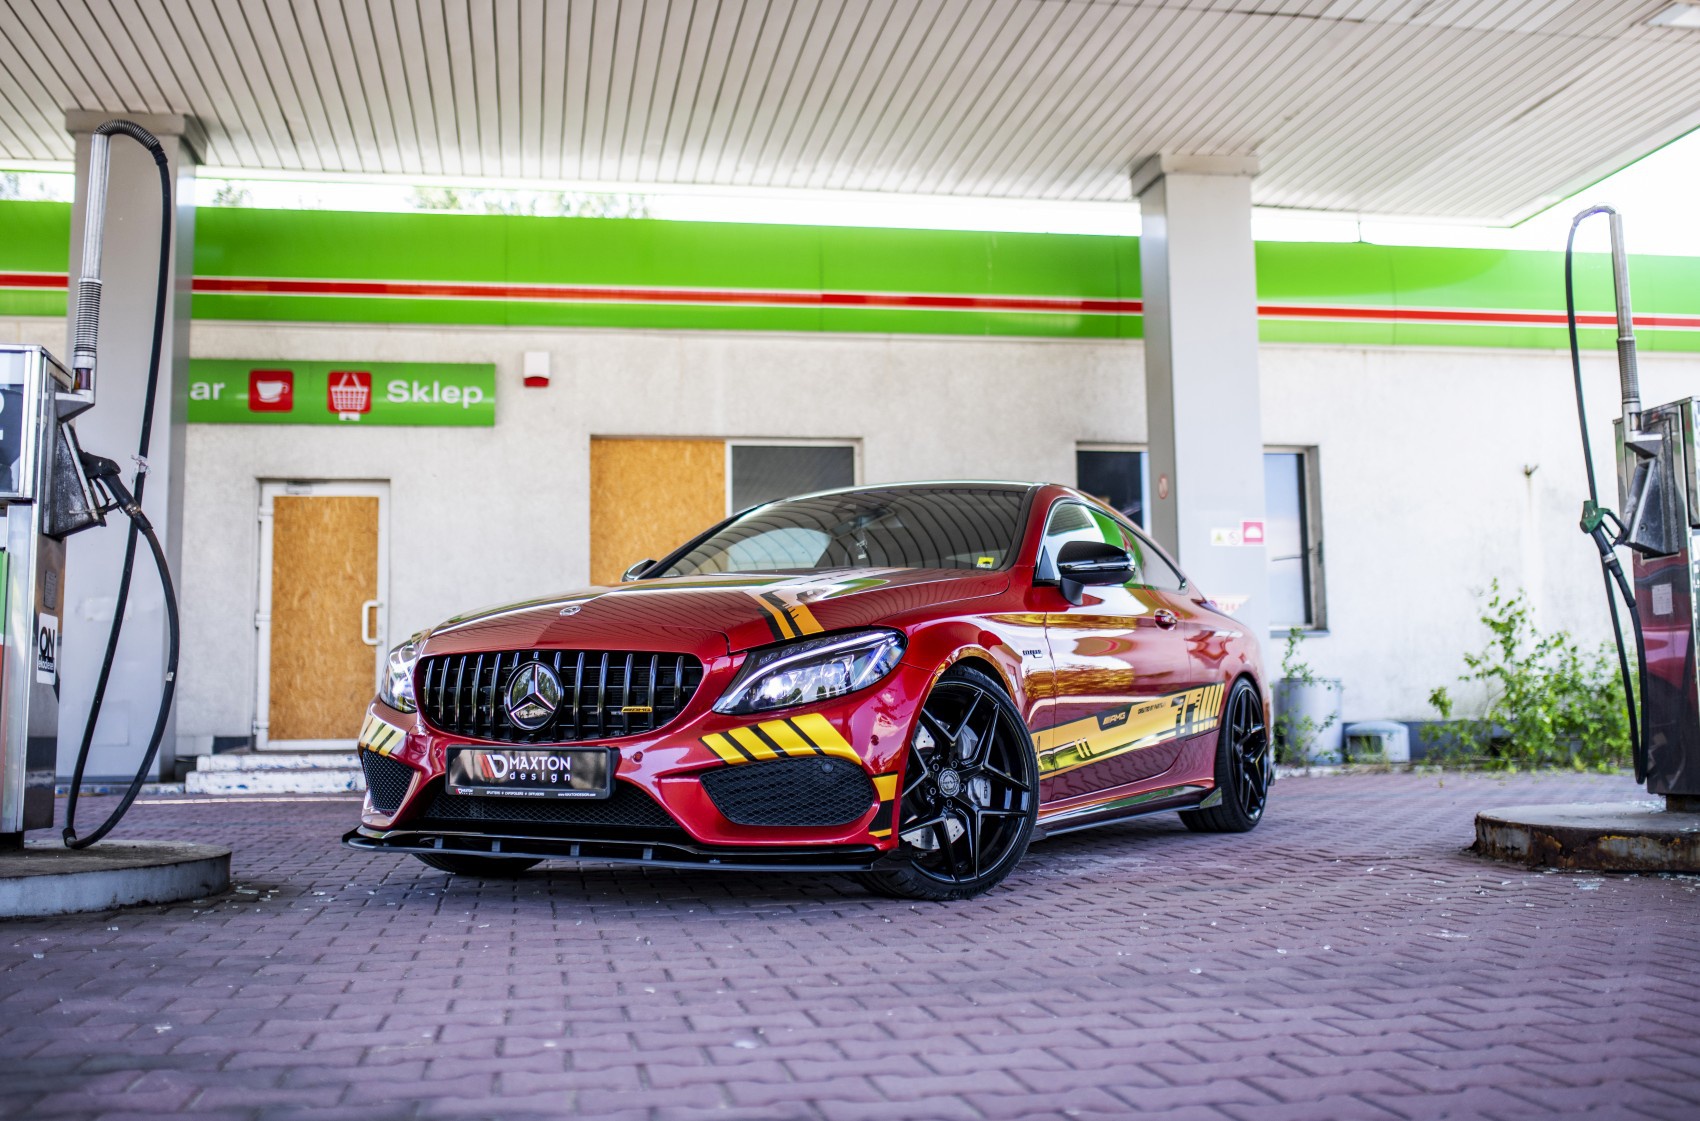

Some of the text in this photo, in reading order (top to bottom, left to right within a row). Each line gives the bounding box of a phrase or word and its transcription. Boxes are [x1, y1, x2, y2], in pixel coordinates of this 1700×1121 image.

[190, 380, 483, 408] ar Sklep
[1103, 712, 1126, 725] AMG
[509, 756, 571, 771] MAXTON
[509, 771, 571, 783] design
